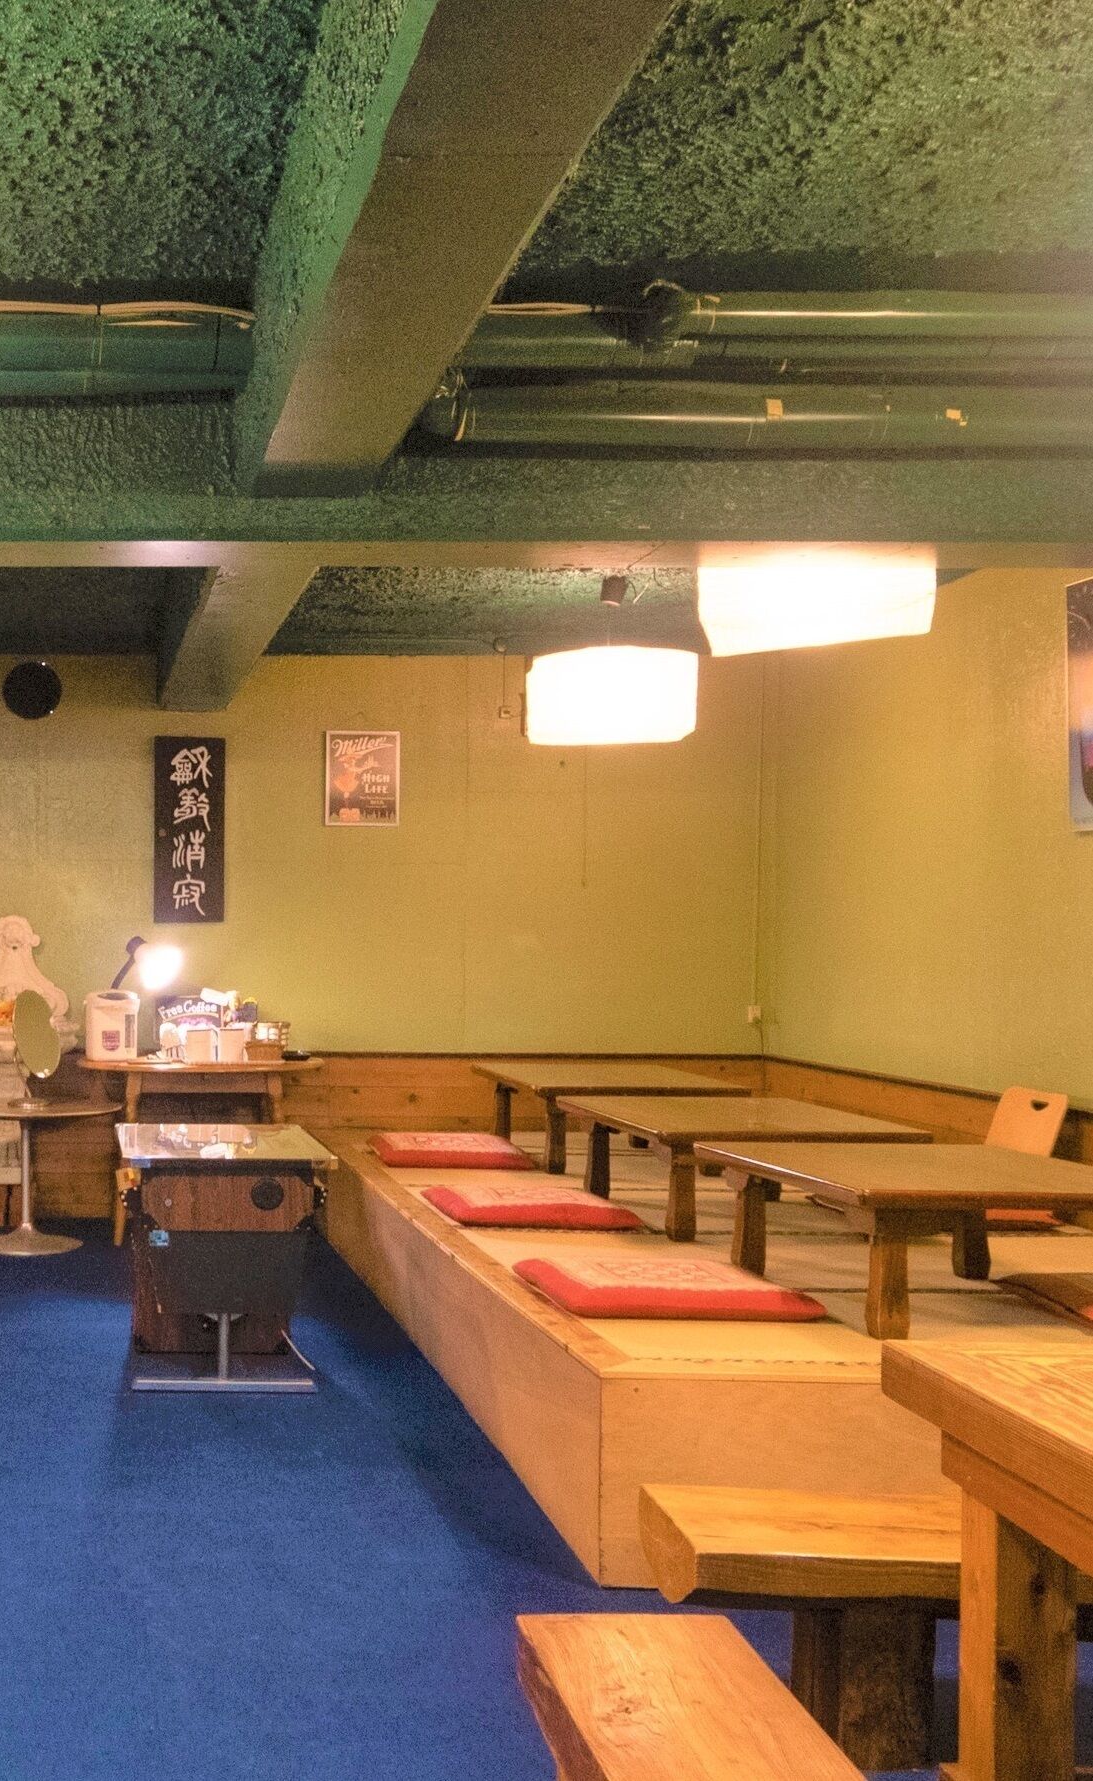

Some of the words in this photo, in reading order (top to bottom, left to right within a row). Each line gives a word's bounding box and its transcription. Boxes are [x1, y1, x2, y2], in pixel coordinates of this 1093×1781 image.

[332, 736, 389, 757] Miller
[158, 1005, 183, 1020] Free
[184, 1000, 218, 1014] Coffee
